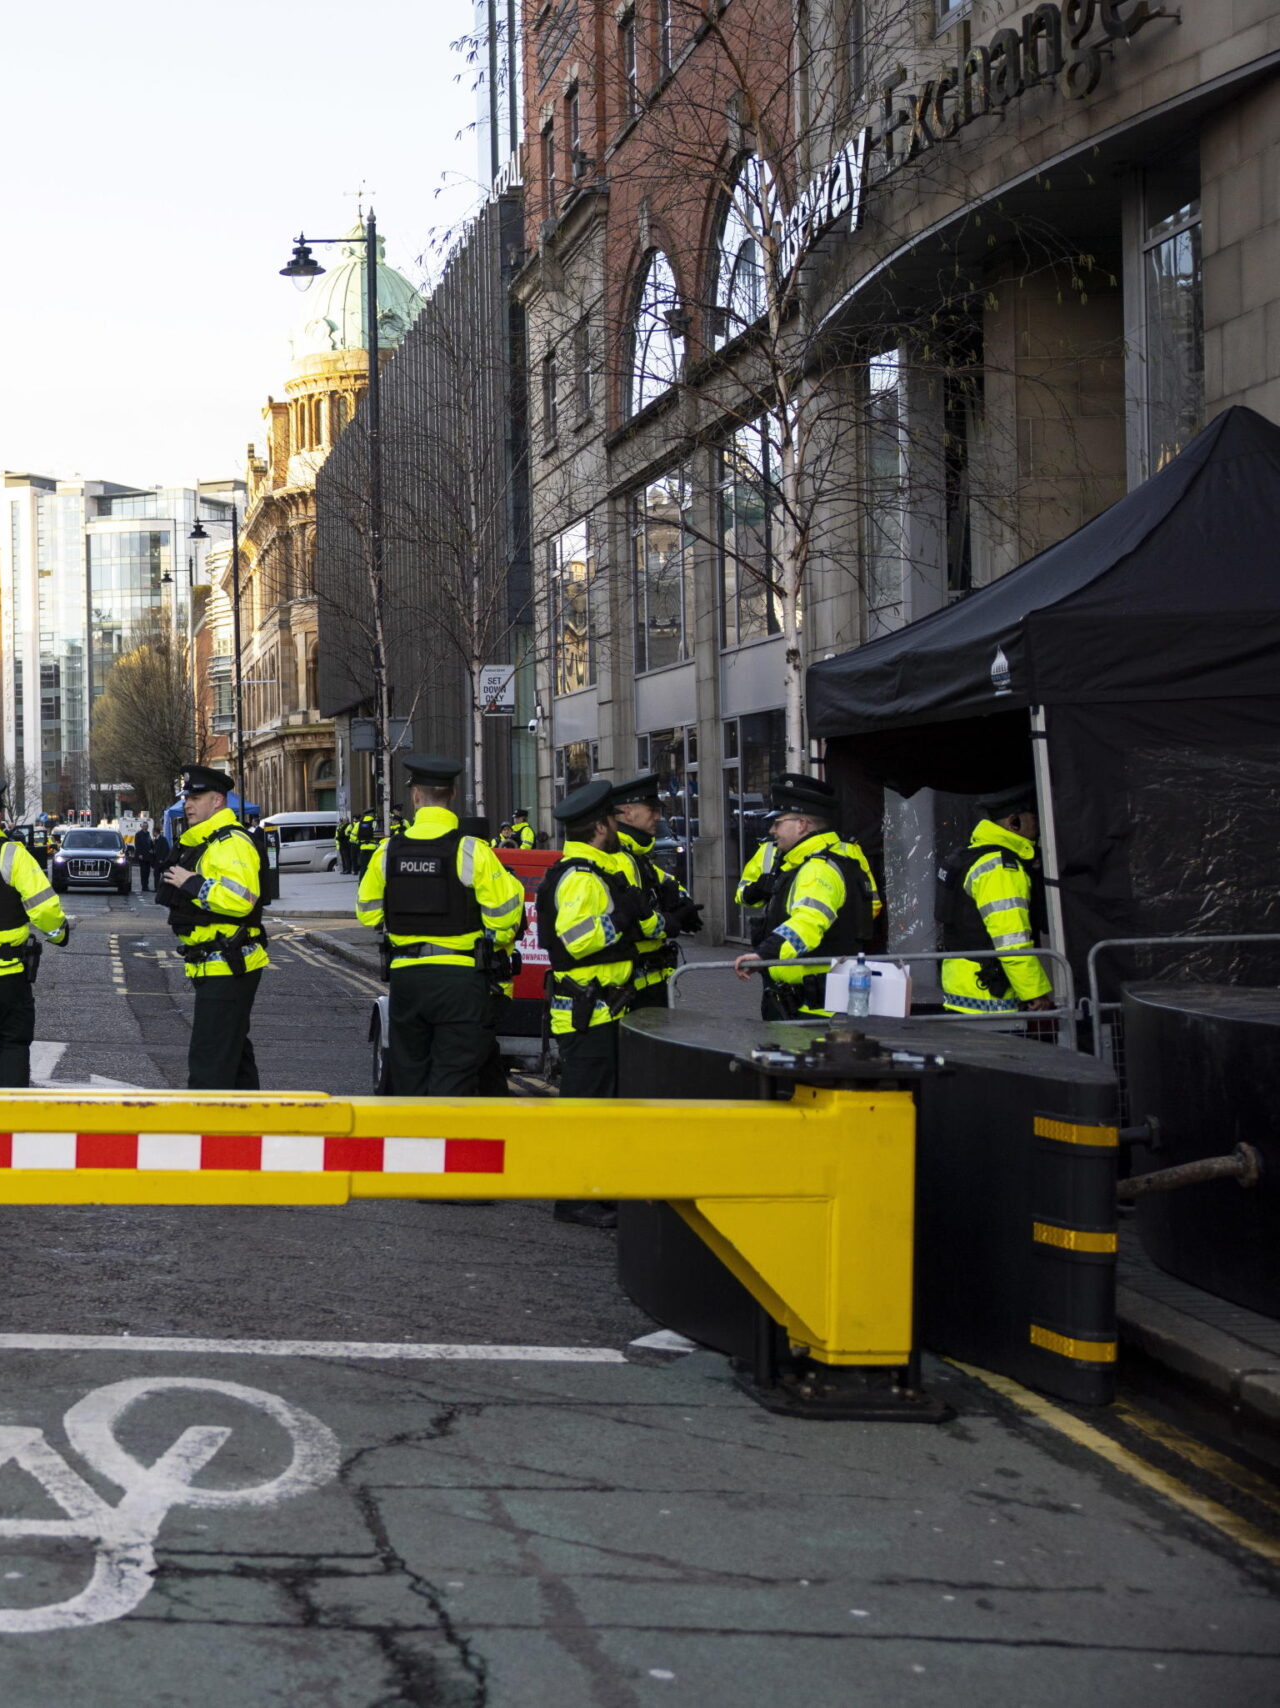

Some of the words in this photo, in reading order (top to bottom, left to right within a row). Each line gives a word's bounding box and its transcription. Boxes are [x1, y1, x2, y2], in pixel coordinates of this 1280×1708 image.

[878, 0, 1163, 168] Exchange
[487, 677, 501, 685] SET
[483, 686, 506, 694] DOWN
[400, 861, 436, 873] POLICE
[520, 937, 536, 950] 44
